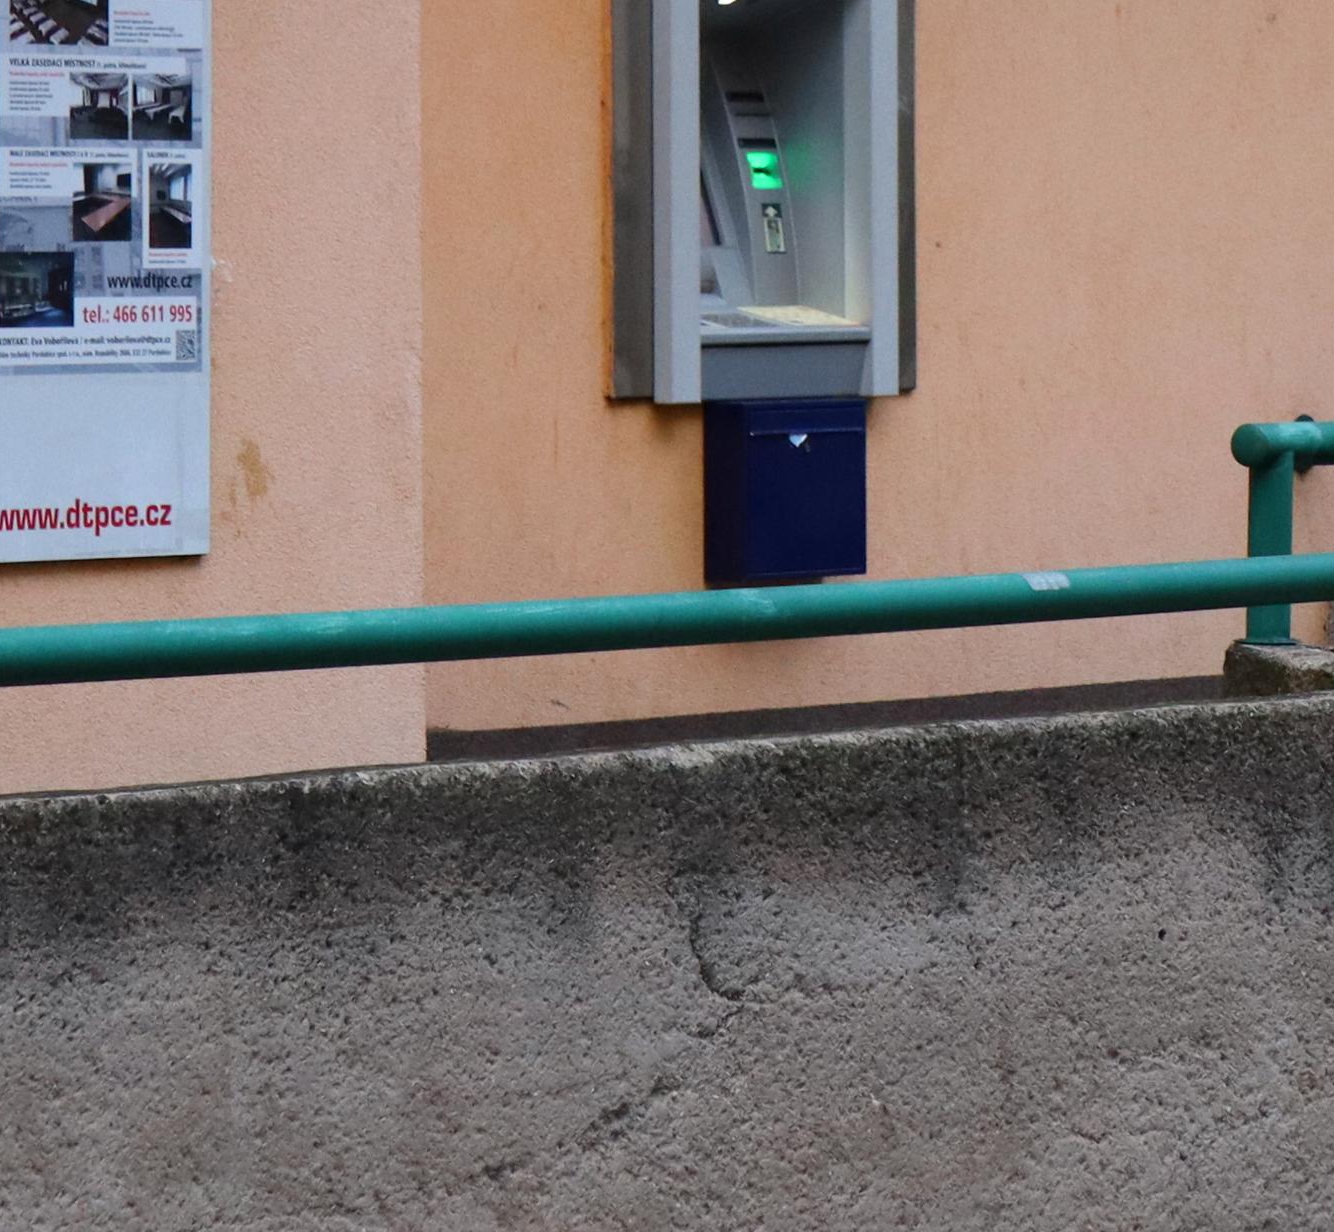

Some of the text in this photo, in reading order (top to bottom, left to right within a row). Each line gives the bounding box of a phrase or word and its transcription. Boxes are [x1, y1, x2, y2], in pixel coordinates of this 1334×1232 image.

[107, 271, 193, 294] www.dtpce.cz
[83, 304, 192, 324] tel.: 466 611 995
